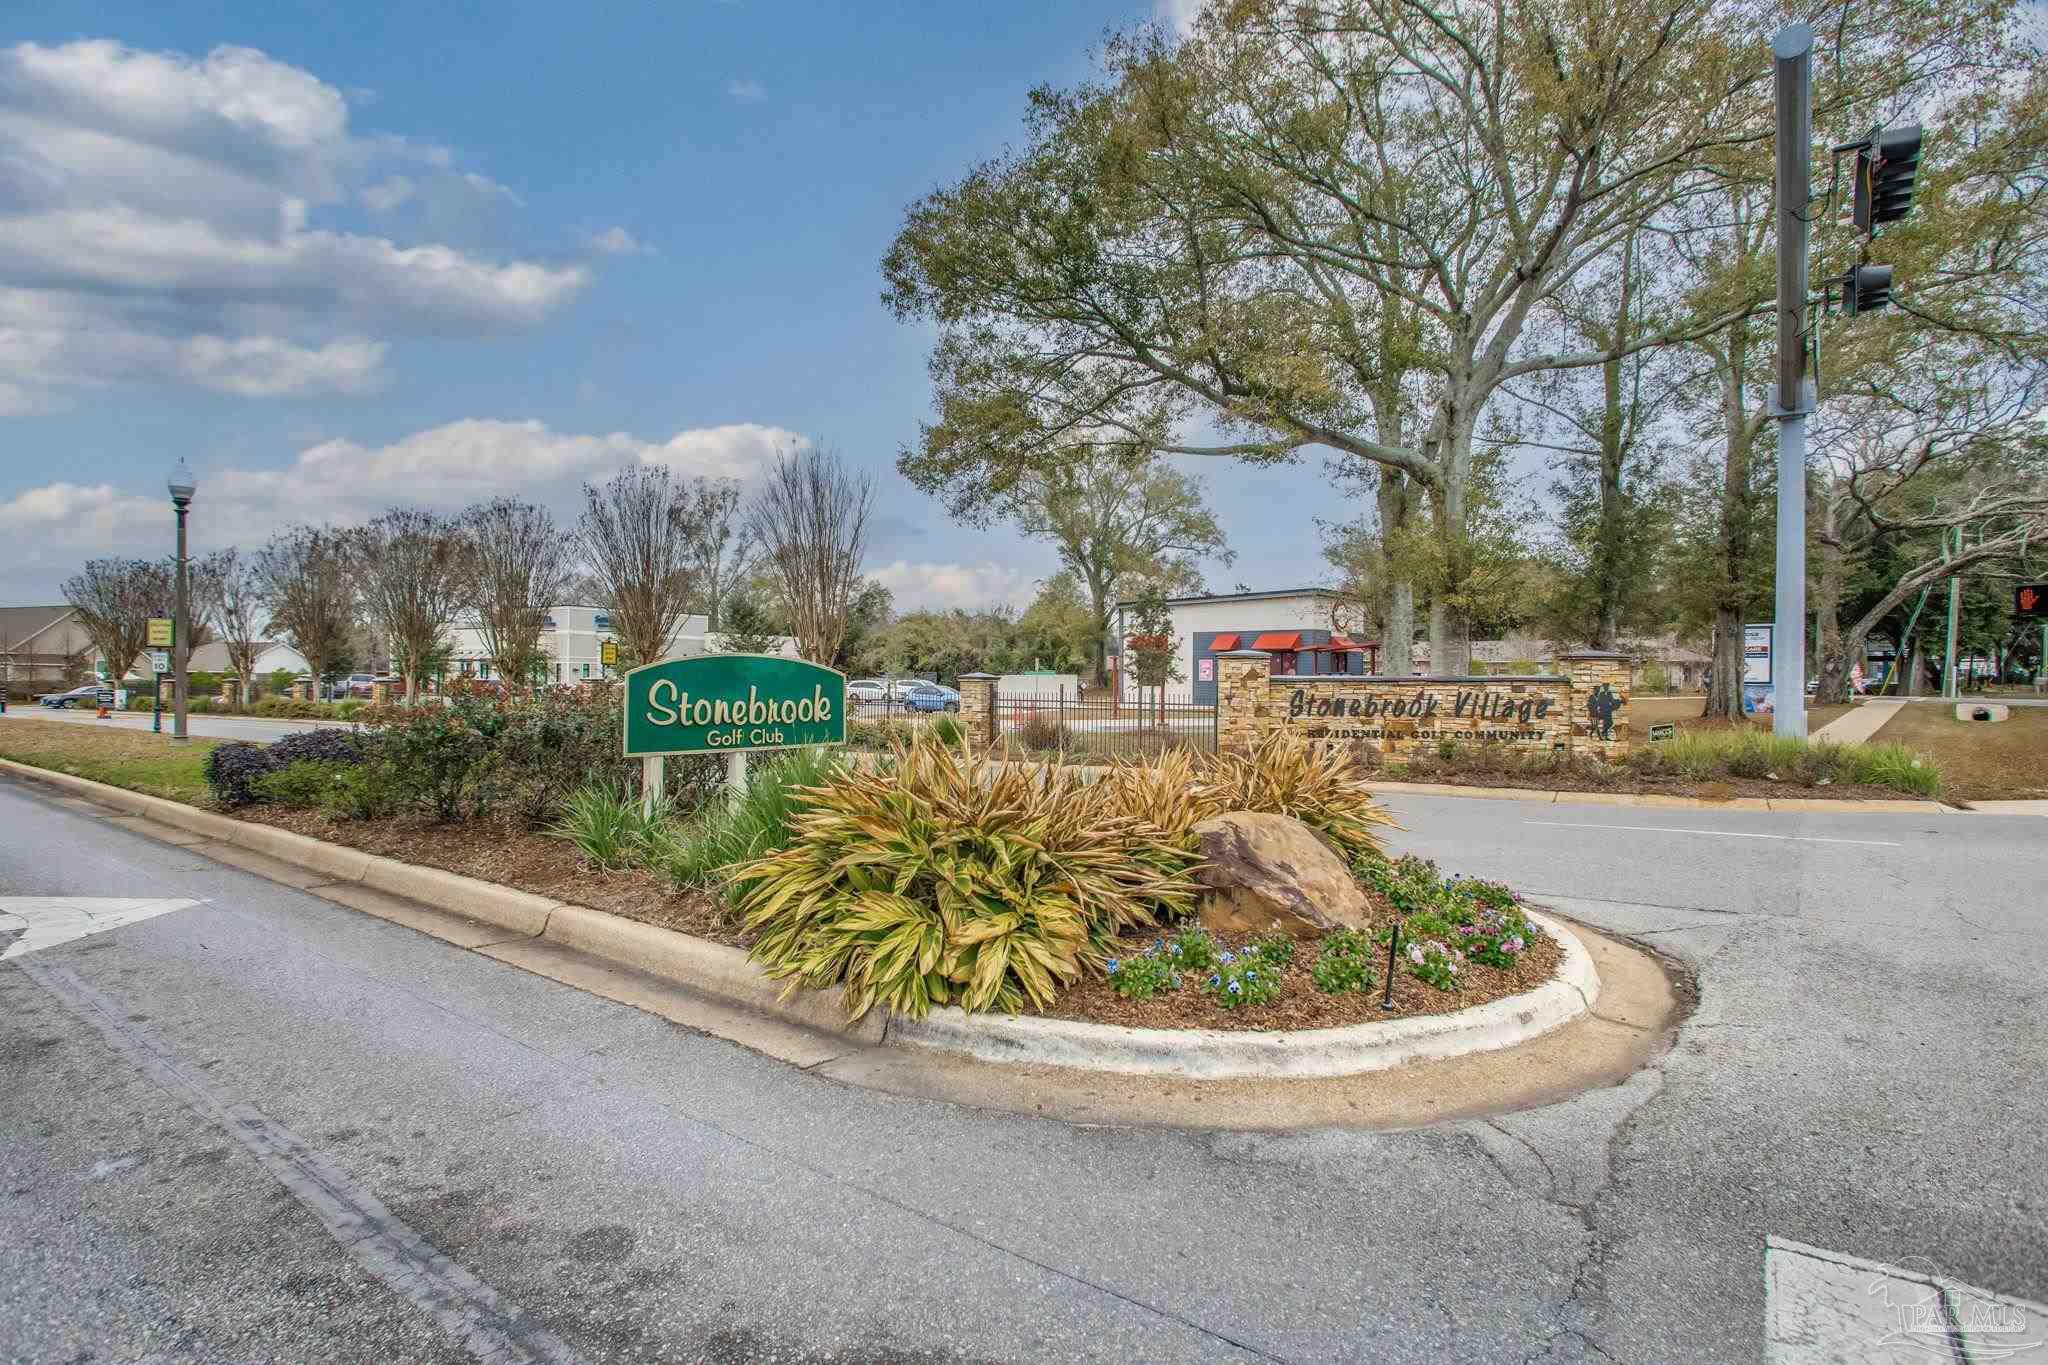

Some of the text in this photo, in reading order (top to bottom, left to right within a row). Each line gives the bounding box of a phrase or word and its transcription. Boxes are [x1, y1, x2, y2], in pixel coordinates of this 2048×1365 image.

[646, 679, 832, 726] Stonebrook
[1289, 689, 1551, 723] Stonebrook Village
[707, 727, 784, 746] Golf Club
[1411, 730, 1449, 739] GOLF
[1455, 730, 1545, 740] COMMUNITY
